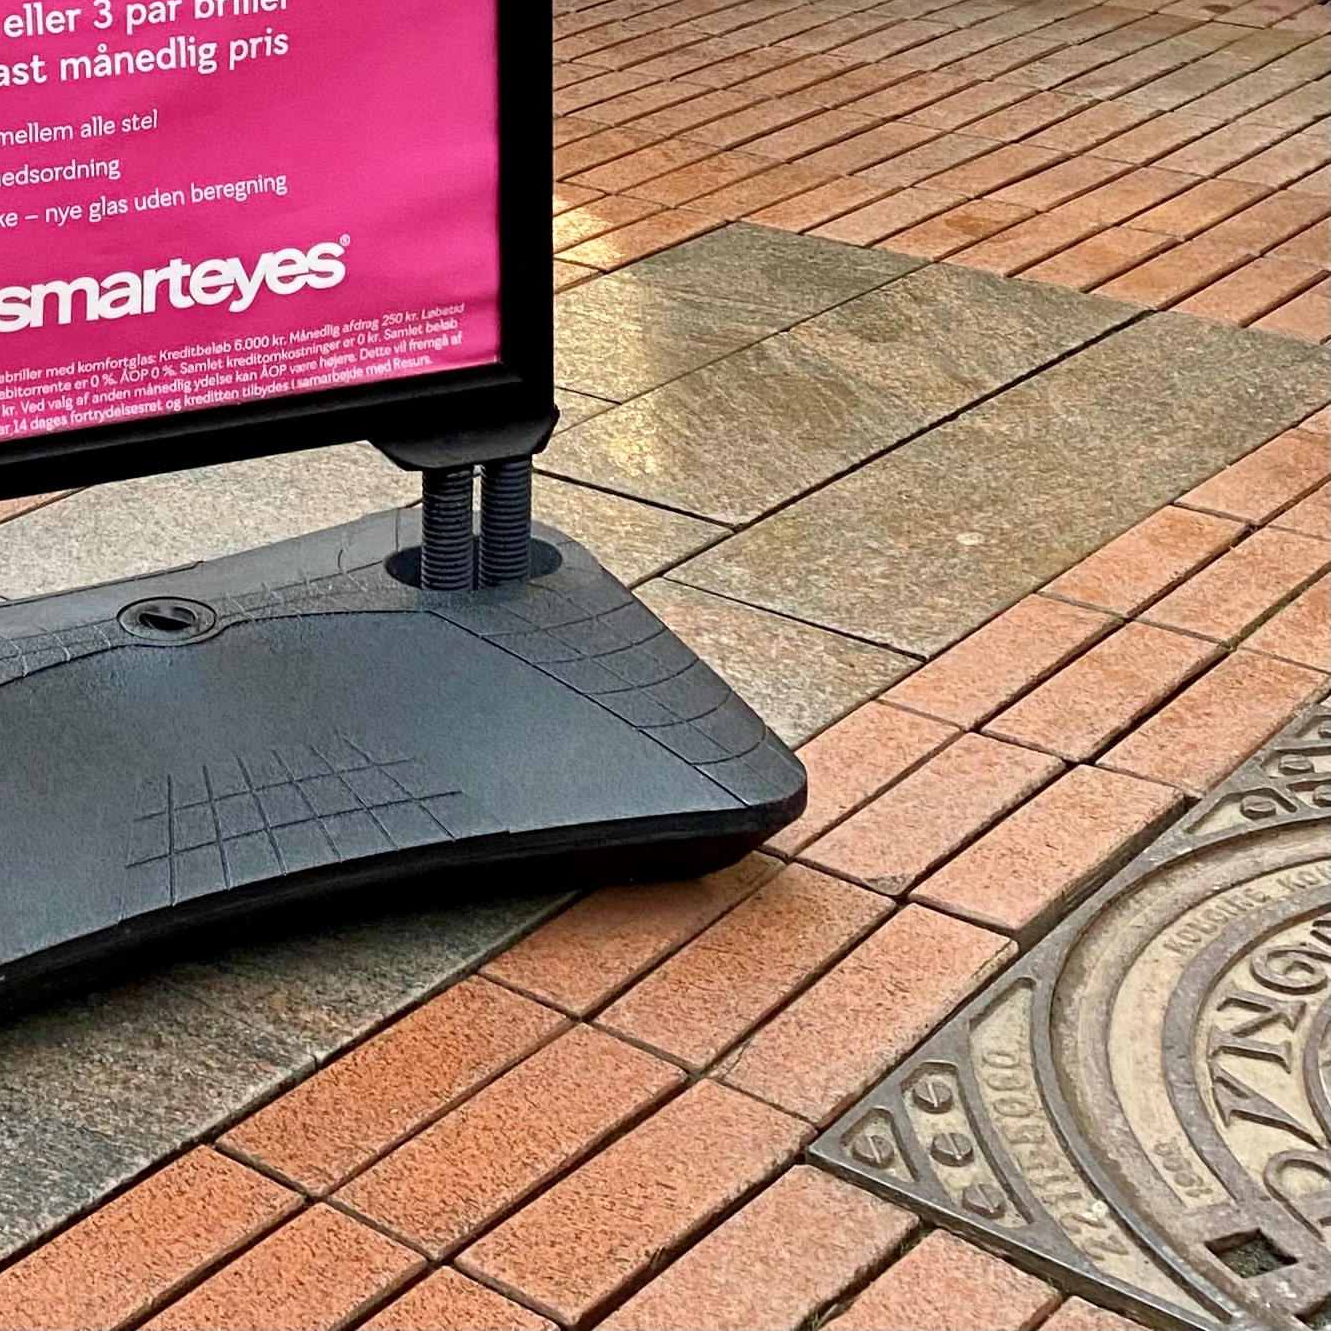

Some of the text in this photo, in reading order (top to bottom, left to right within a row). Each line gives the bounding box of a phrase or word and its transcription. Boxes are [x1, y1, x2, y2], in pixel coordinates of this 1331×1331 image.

[3, 2, 81, 38] eller
[60, 36, 217, 81] månedlig
[229, 27, 288, 70] pris
[80, 115, 116, 138] alle
[121, 109, 158, 133] stel
[45, 203, 82, 228] nye
[89, 195, 128, 224] glas
[134, 189, 185, 213] uden
[191, 174, 287, 204] beregning
[46, 363, 74, 378] med
[77, 354, 156, 375] komfortglas:
[159, 342, 231, 362] Kreditbeløb
[234, 336, 269, 351] 6.000
[272, 334, 287, 346] kr.
[290, 323, 340, 344] Månedlig
[342, 319, 379, 334] afdrag
[382, 313, 403, 327] 250
[405, 311, 418, 322] kr.
[421, 303, 465, 319] Løbetid
[74, 379, 88, 390] er
[91, 375, 99, 387] 0
[121, 368, 149, 383] ÅOP
[151, 367, 159, 379] 0
[180, 358, 223, 374] Samlet
[226, 341, 341, 368] kreditomkostninger
[343, 336, 355, 347] er
[357, 333, 366, 345] 0
[368, 332, 381, 343] kr.
[384, 324, 423, 340] Samlet
[426, 318, 458, 333] beløb
[2, 403, 17, 418] kr.
[21, 399, 45, 413] Ved
[48, 395, 73, 411] valg
[76, 392, 88, 406] af
[92, 389, 131, 404] anden
[134, 379, 192, 398] månedlig
[194, 373, 233, 392] ydelse
[236, 370, 257, 382] kan
[260, 364, 287, 379] ÅOP
[360, 345, 391, 360] Dette
[394, 341, 406, 354] vil
[409, 334, 448, 351] fremgå
[451, 331, 463, 345] af
[13, 418, 27, 432] 14
[30, 415, 67, 431] dages
[70, 399, 162, 423] fortrydelsesret
[166, 400, 181, 411] og
[184, 388, 239, 406] kreditten
[243, 382, 289, 398] tilbydes
[297, 367, 363, 387] samarbejde
[366, 361, 391, 376] med
